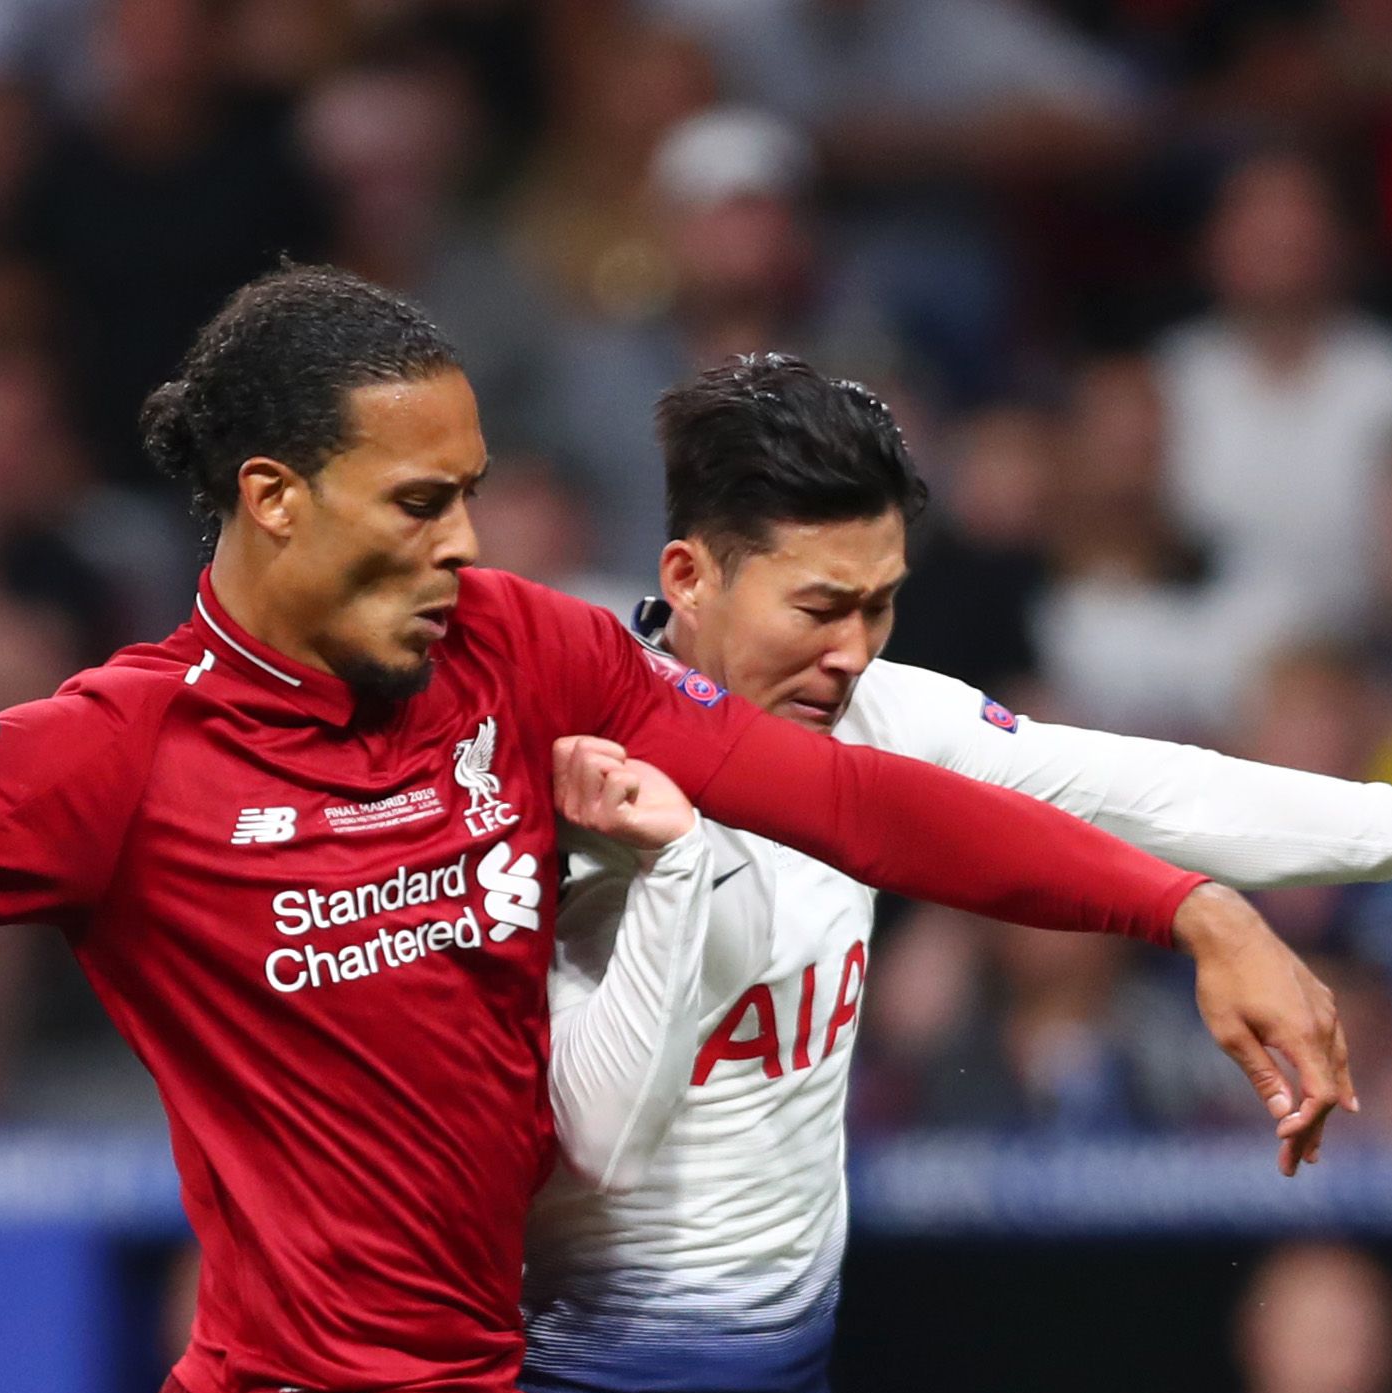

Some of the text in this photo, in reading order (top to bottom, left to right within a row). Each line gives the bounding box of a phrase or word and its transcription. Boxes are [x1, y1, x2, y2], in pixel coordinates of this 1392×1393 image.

[323, 803, 359, 819] FINAL
[358, 794, 408, 815] MADRID
[407, 787, 436, 804] 2019
[272, 854, 467, 935] Standard
[265, 906, 482, 993] Chartered
